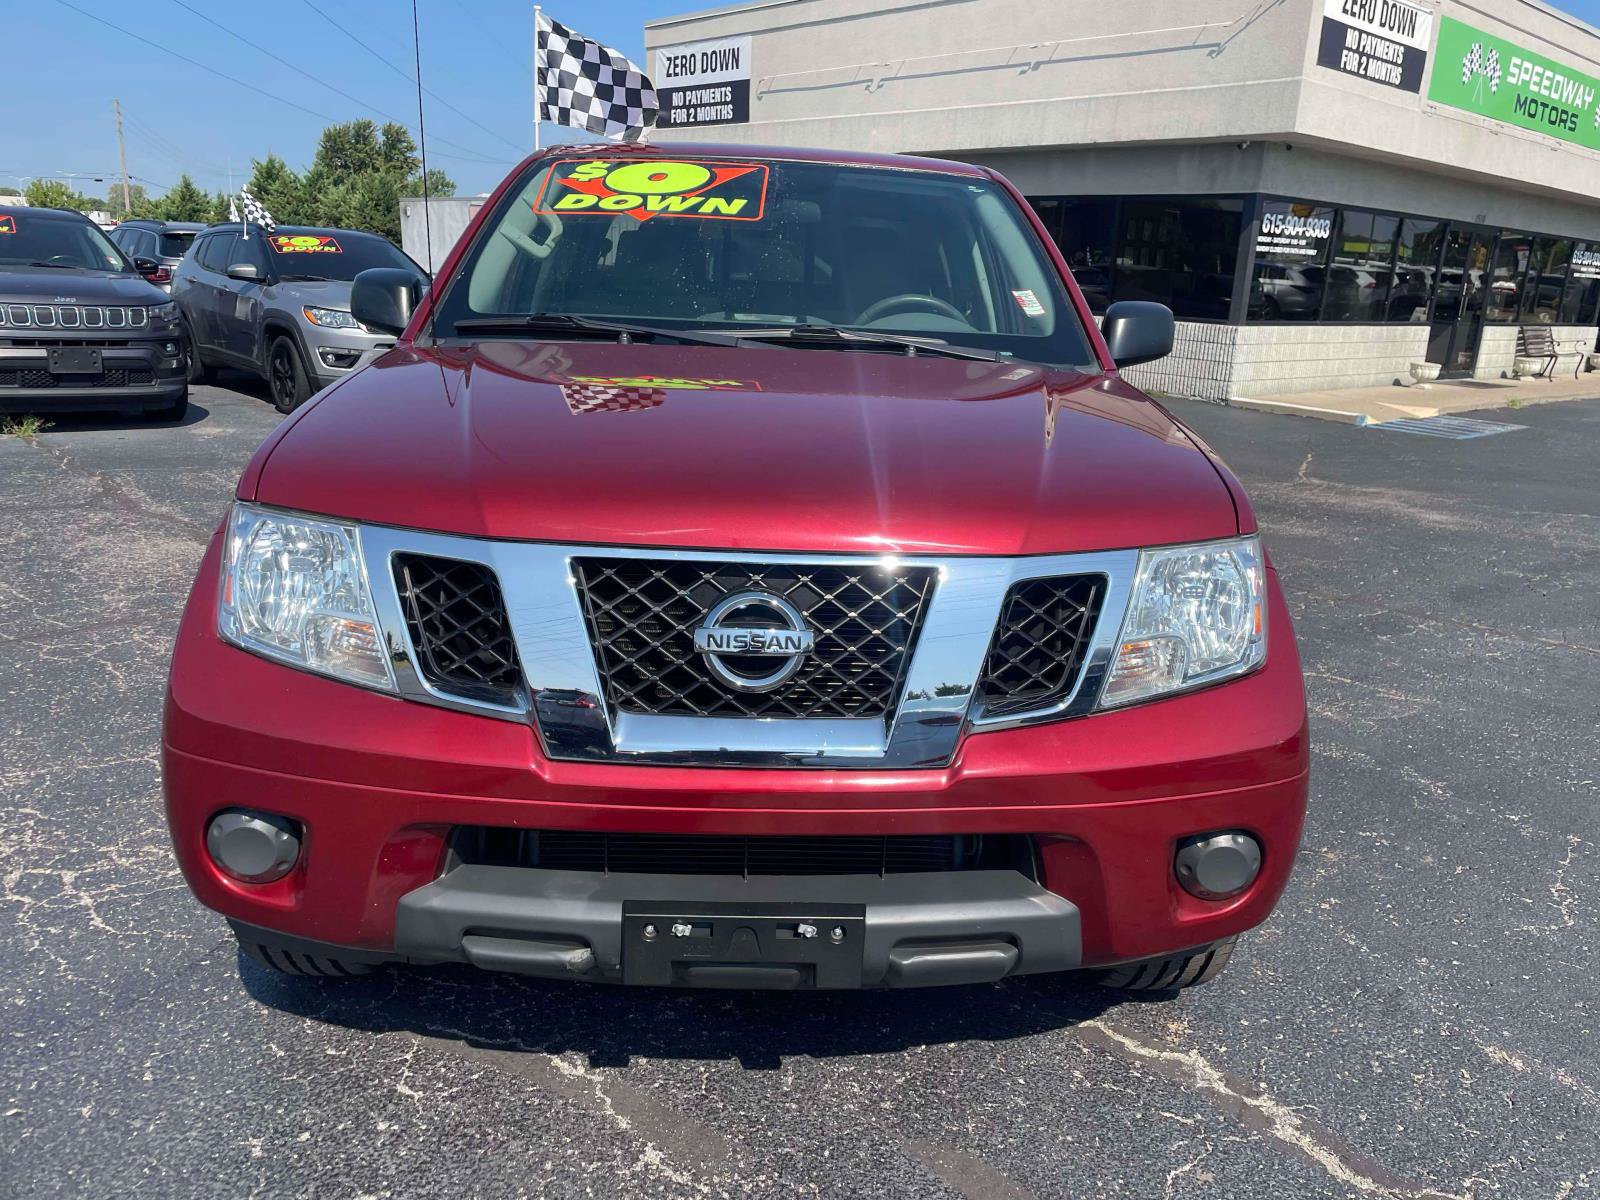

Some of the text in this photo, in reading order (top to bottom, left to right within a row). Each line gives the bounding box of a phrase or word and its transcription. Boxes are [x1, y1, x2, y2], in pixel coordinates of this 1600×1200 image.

[1379, 0, 1418, 39] DOWN
[1345, 27, 1405, 64] NO PAYMENTS
[666, 47, 740, 78] ZERO DOWN
[1340, 49, 1403, 85] FOR 2 MONTHS
[672, 86, 732, 107] NO PAYMENTS
[1506, 56, 1595, 110] SPEEDWAY
[670, 104, 734, 124] FOR 2 MONTHS
[1514, 93, 1579, 132] MOTORS
[553, 193, 748, 215] DOWN
[706, 633, 802, 650] NISSAN
